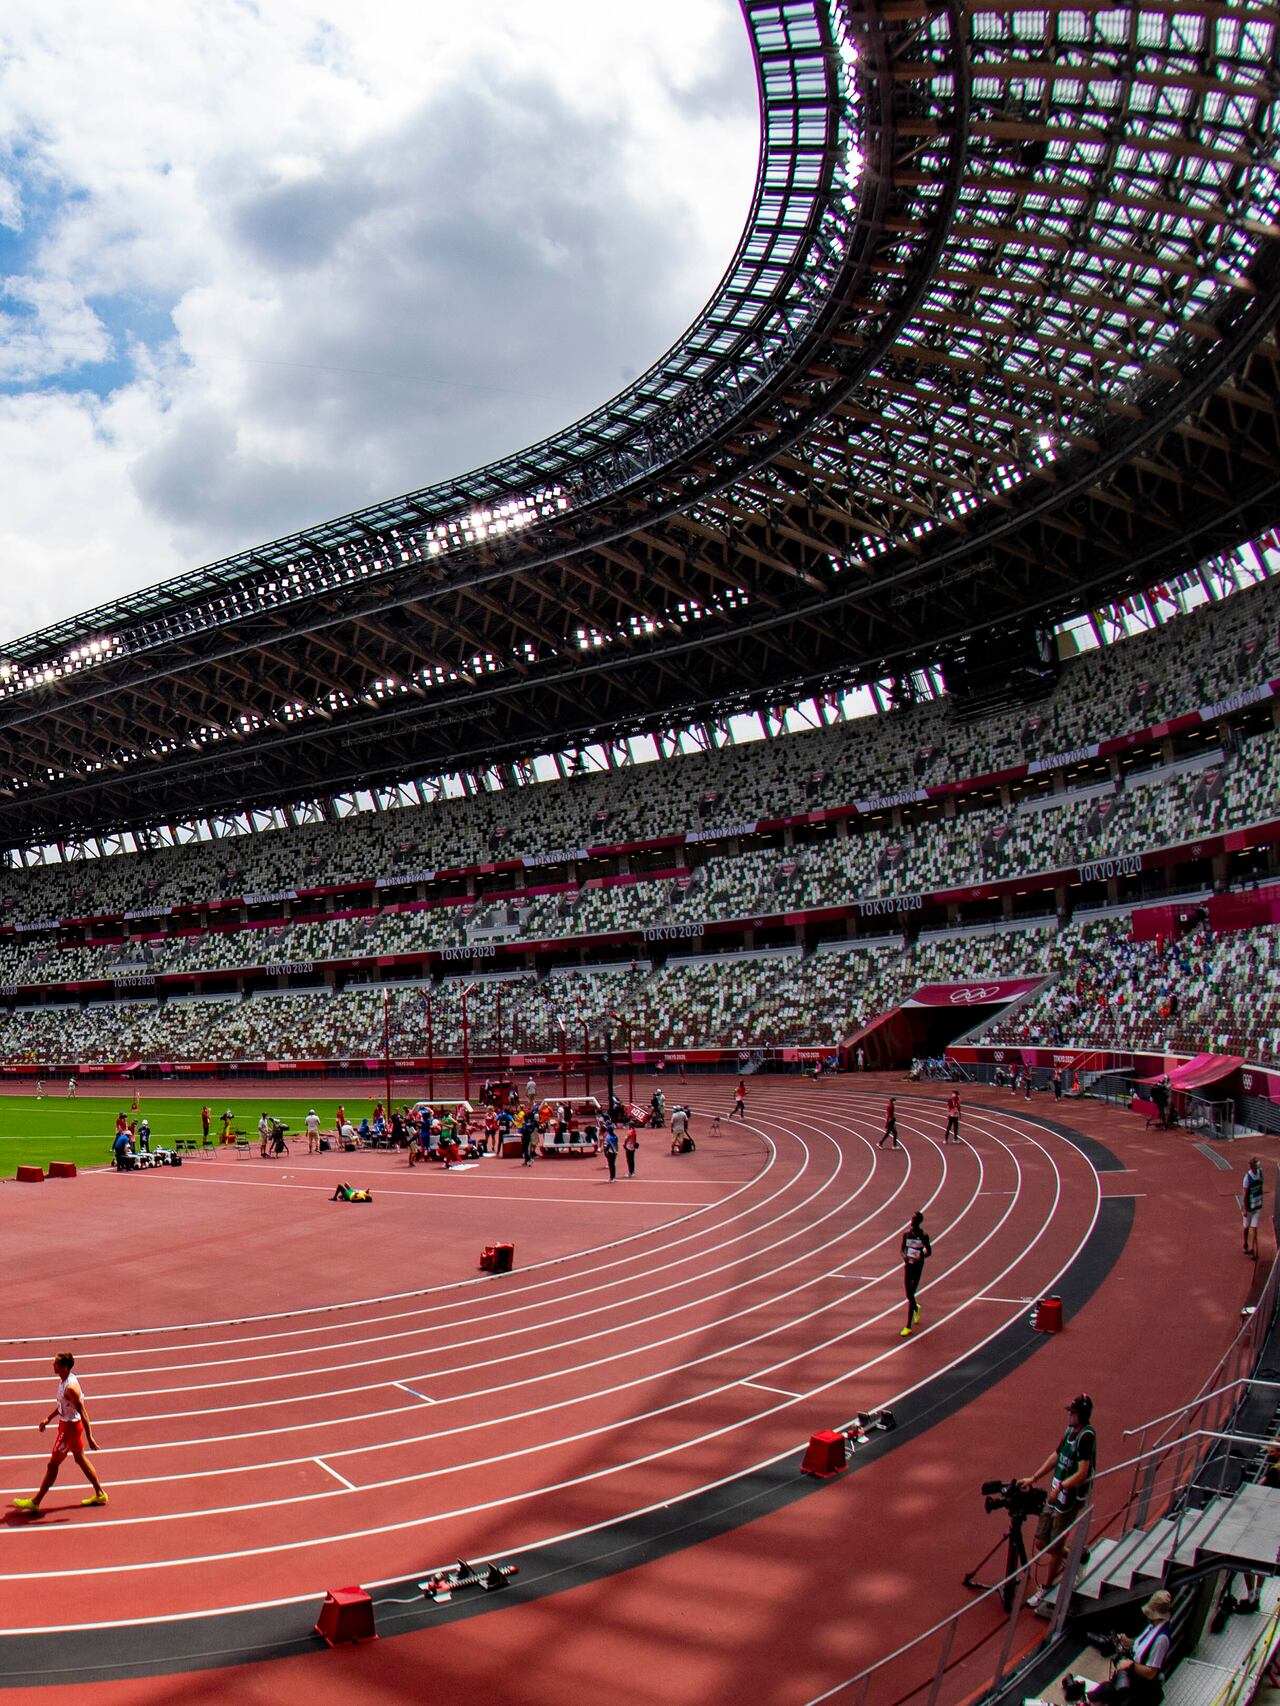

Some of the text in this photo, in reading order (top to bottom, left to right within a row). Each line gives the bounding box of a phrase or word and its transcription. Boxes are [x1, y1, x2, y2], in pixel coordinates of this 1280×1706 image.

[1210, 687, 1262, 716] TOKYO 2020
[1038, 749, 1089, 772] TOKYO 2020
[868, 791, 918, 810] TOKYO 2020
[696, 824, 746, 840] TOKYO 2020
[532, 851, 579, 865] TOKYO 2020
[1077, 855, 1143, 884] TOKYO 2020
[384, 873, 426, 887] TOKYO 2020
[251, 891, 289, 904] TOKYO 2020
[858, 896, 923, 918] TOKYO 2020
[641, 924, 706, 942] TOKYO 2020
[439, 945, 496, 961] TOKYO 2020
[265, 962, 314, 976] TOKYO 2020
[113, 976, 156, 988] TOKYO 2020
[2, 987, 18, 996] 2020
